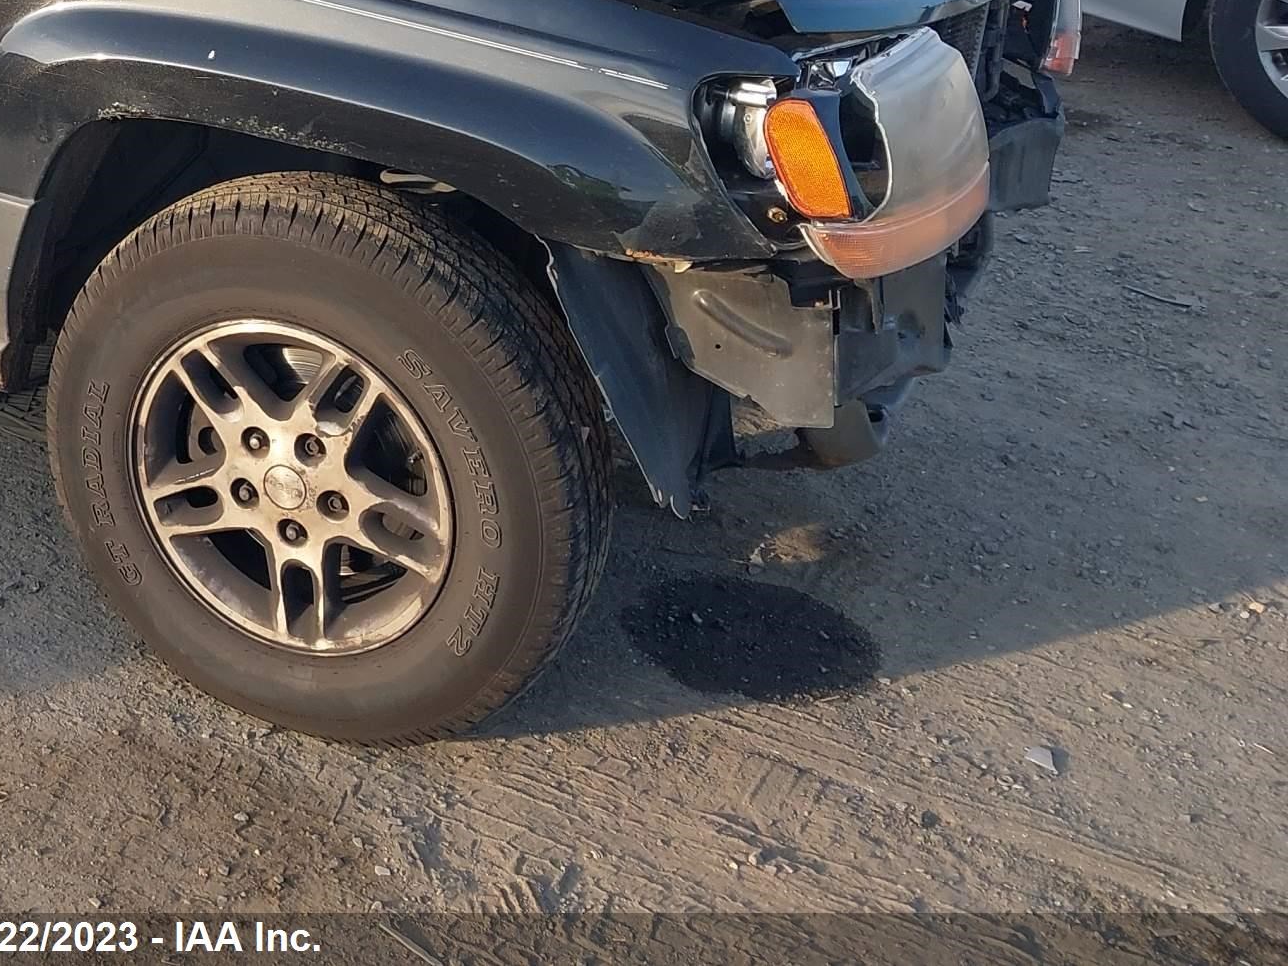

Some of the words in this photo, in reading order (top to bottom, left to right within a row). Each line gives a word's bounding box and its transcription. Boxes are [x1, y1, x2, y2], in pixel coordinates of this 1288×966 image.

[80, 379, 116, 528] RADIAL
[396, 349, 502, 549] SAVERO
[105, 540, 143, 586] GT
[446, 566, 500, 657] HT2
